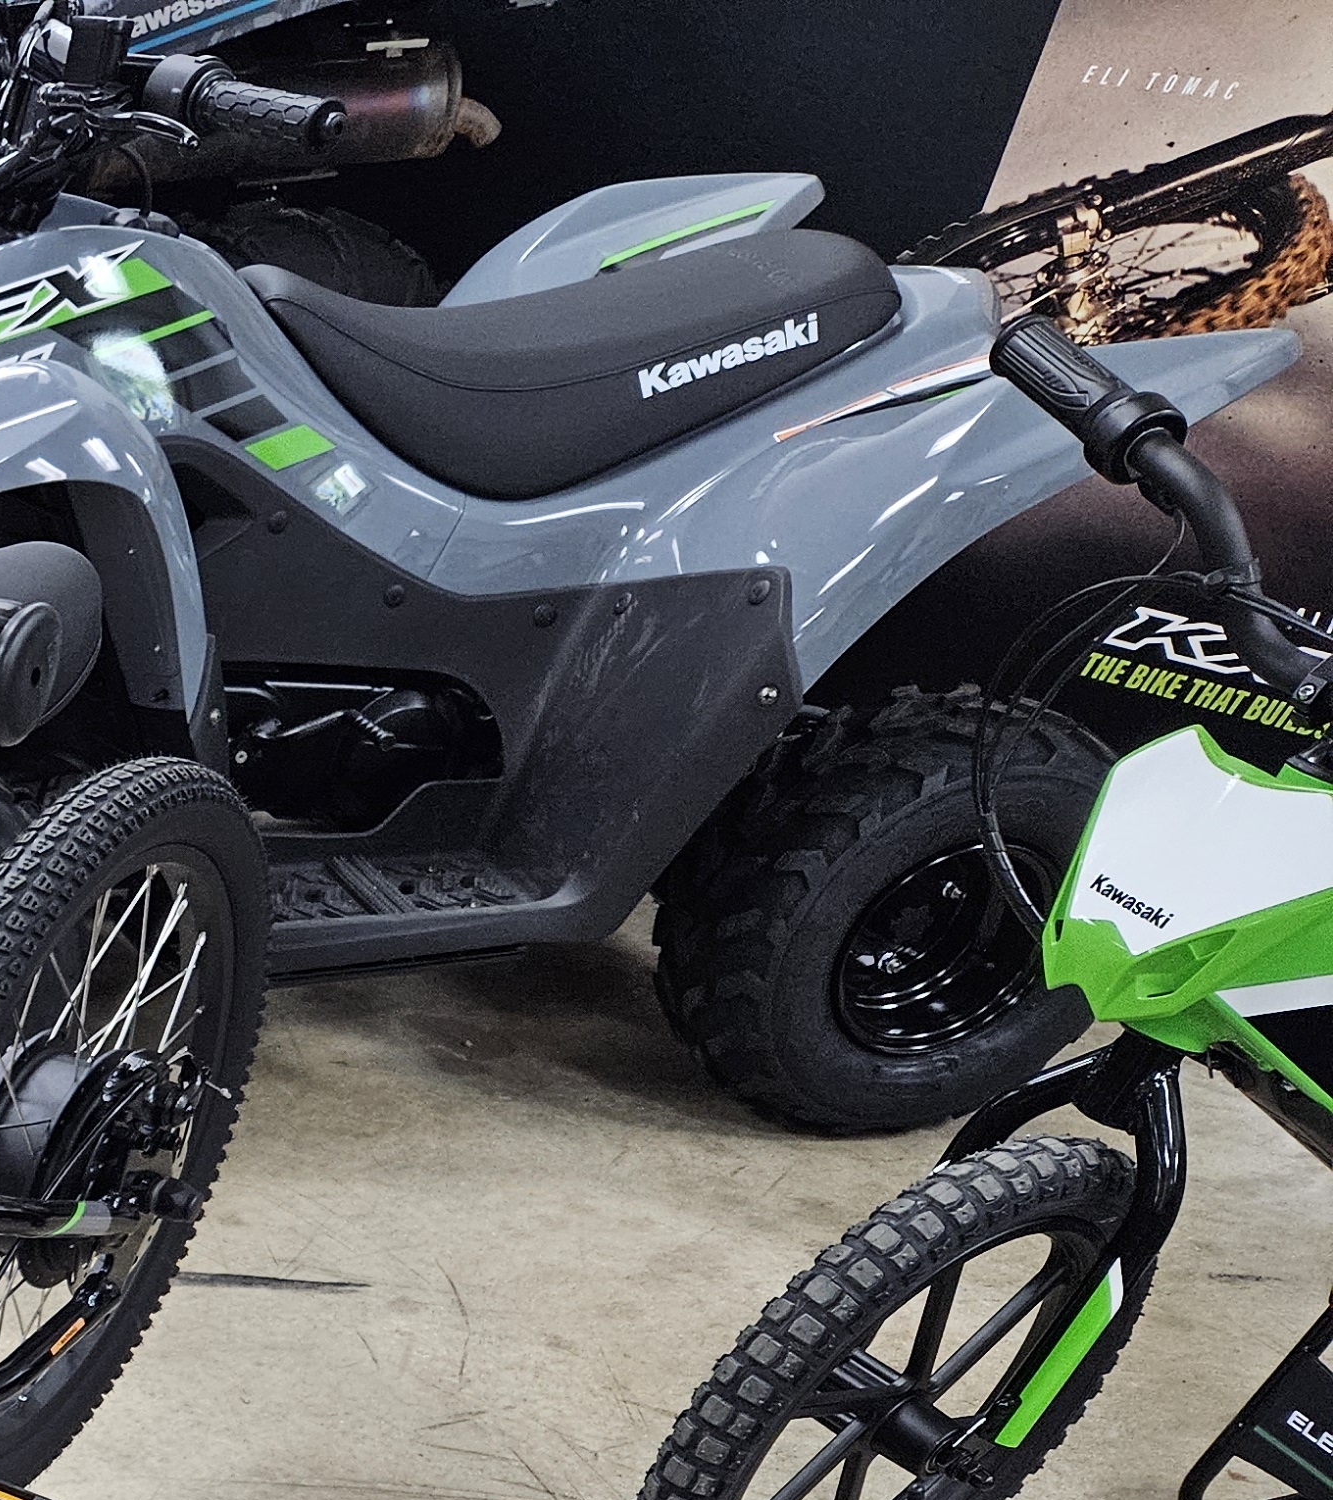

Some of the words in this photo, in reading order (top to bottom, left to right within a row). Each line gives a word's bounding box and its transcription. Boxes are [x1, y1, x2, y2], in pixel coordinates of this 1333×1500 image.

[1081, 65, 1130, 87] ELI
[1145, 72, 1240, 101] TOMAC
[637, 312, 820, 400] Kawasaki
[1080, 652, 1132, 685] THE
[1124, 664, 1189, 700] BIKE
[1183, 678, 1251, 716] THAT
[1089, 873, 1175, 930] Kawasaki
[1286, 1410, 1333, 1456] ELE
